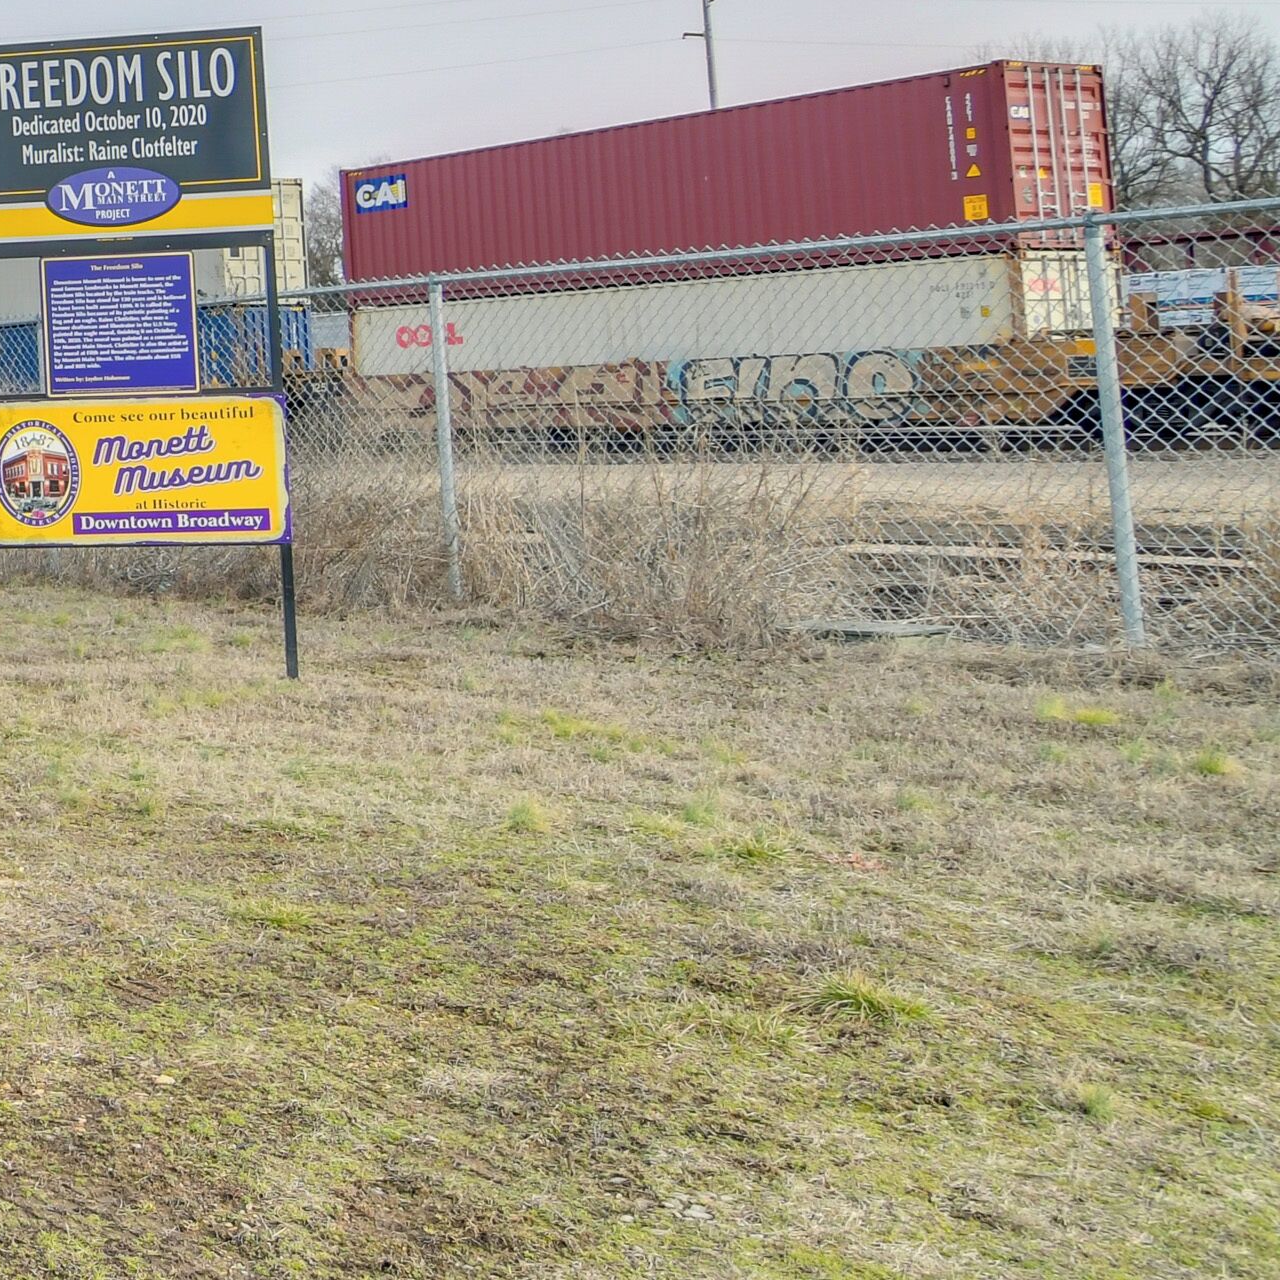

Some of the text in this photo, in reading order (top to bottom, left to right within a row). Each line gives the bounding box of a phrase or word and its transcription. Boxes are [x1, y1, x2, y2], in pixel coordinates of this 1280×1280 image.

[156, 47, 235, 101] SILO
[12, 104, 207, 137] Dedicated October 10, 2020
[22, 138, 198, 165] Muralist: Raine Clotfelter
[107, 171, 115, 179] A
[97, 192, 167, 205] MAIN STREET
[356, 179, 407, 209] CAI
[95, 208, 130, 220] PROJECT
[396, 322, 464, 348] OOL
[72, 406, 254, 424] Come see our beautiful
[5, 421, 62, 438] HISTORICAL
[92, 425, 215, 465] Monett
[113, 458, 262, 495] Museum
[135, 498, 207, 510] at Historic
[80, 513, 263, 531] Downtown Broadway
